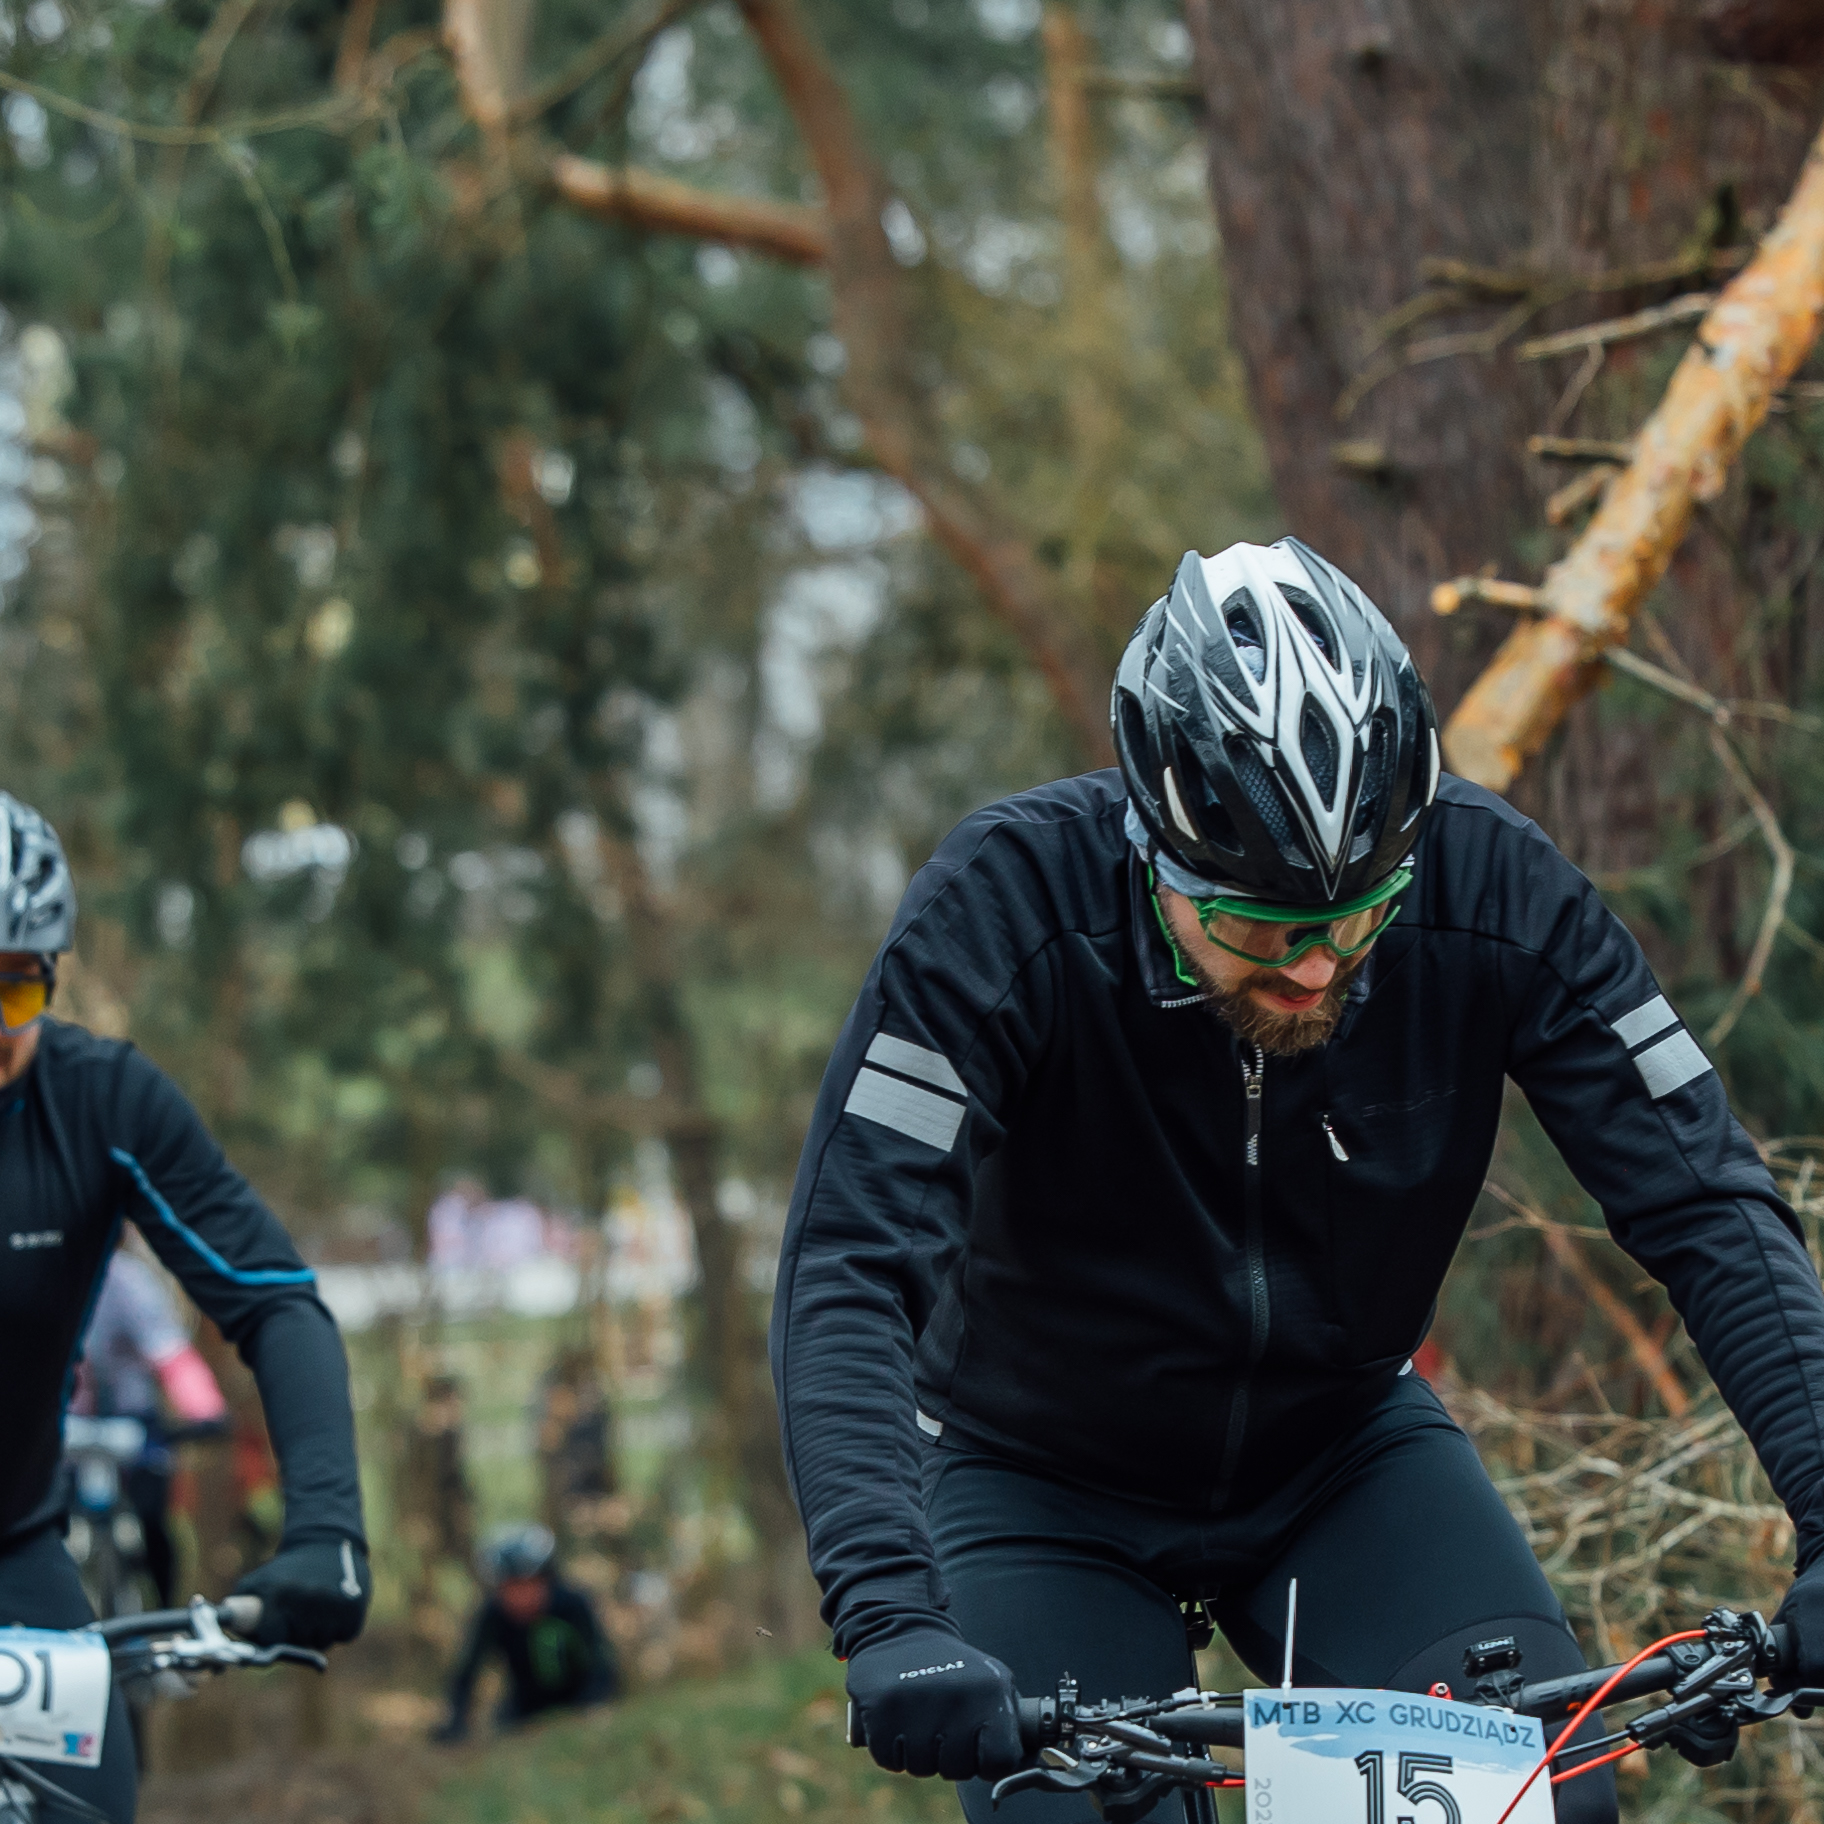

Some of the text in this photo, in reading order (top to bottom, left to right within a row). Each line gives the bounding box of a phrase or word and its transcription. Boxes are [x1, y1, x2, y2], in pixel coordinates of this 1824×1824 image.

[899, 1660, 966, 1680] FORCLAZ
[1253, 1701, 1536, 1748] MTB XC GRUDZIĄDZ
